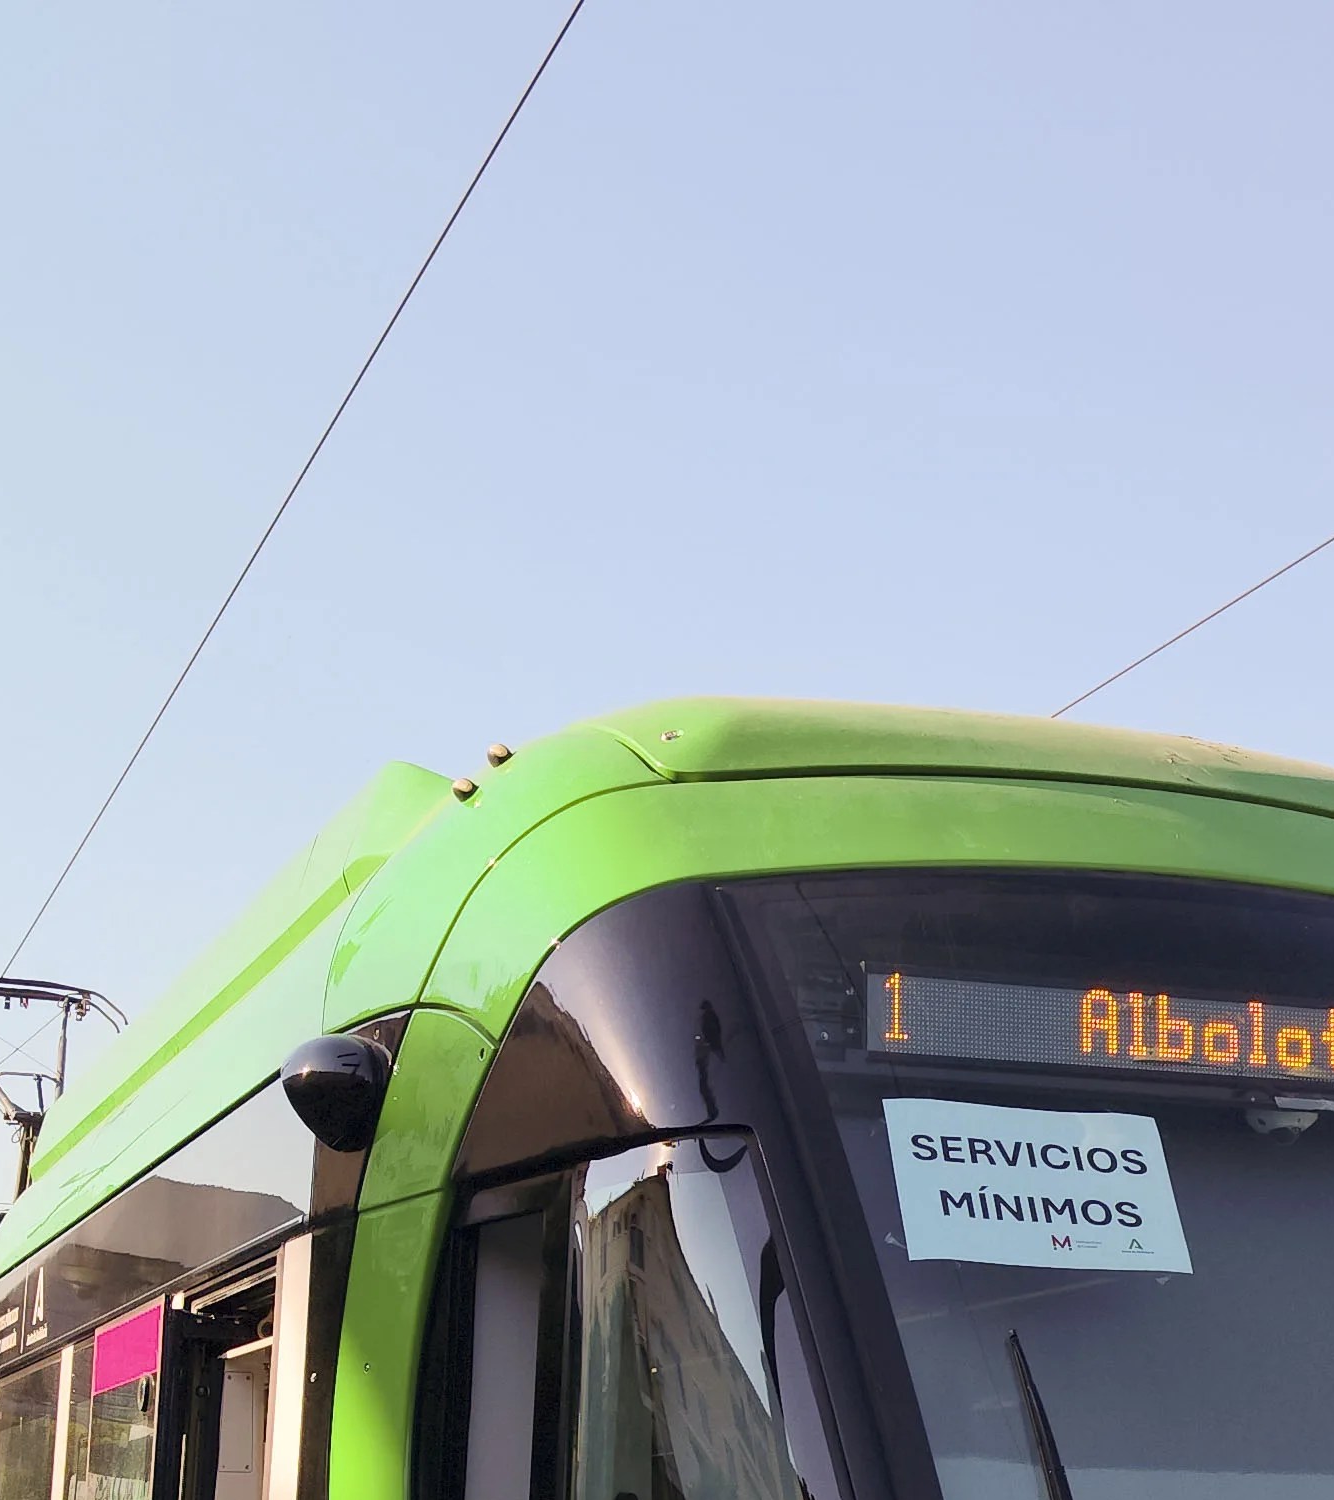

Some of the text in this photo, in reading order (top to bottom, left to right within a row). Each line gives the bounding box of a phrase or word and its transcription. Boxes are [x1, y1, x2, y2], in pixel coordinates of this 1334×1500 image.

[884, 972, 909, 1042] 1
[910, 1134, 1148, 1176] SERVICIOS
[940, 1186, 1143, 1229] MÍNIMOS
